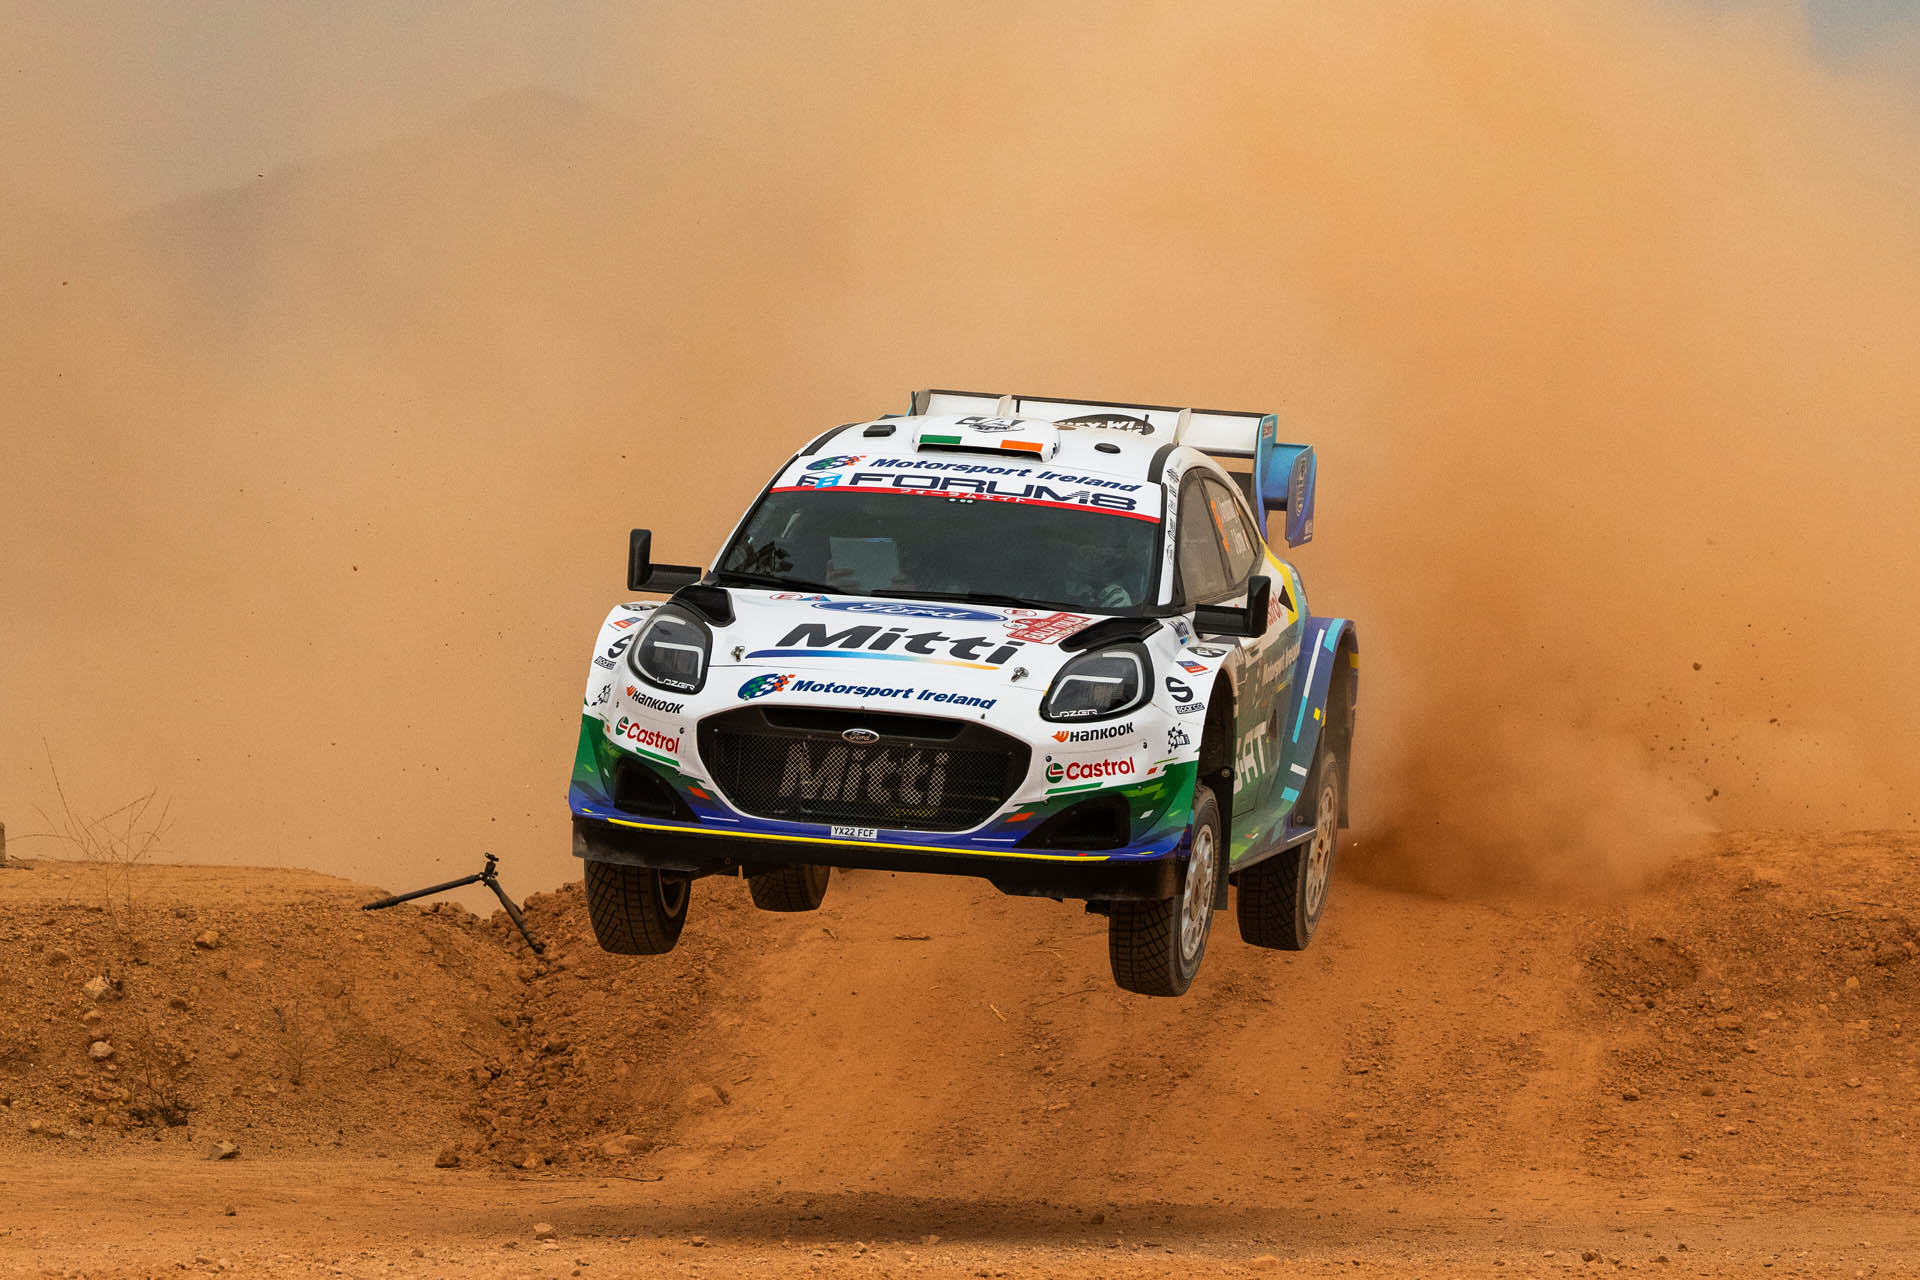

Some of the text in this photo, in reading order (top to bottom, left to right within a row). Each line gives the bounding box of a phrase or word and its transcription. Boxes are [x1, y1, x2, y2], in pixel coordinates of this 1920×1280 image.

[869, 458, 1032, 478] Motorsport
[1036, 471, 1142, 492] Ireland
[849, 473, 1137, 511] FORUM8
[775, 623, 1026, 665] Mitti
[791, 680, 998, 709] Motorsport Ireland
[627, 722, 680, 754] Castrol
[777, 743, 949, 806] Mitti
[1066, 757, 1135, 780] Castrol
[834, 826, 875, 838] YX22 FCF
